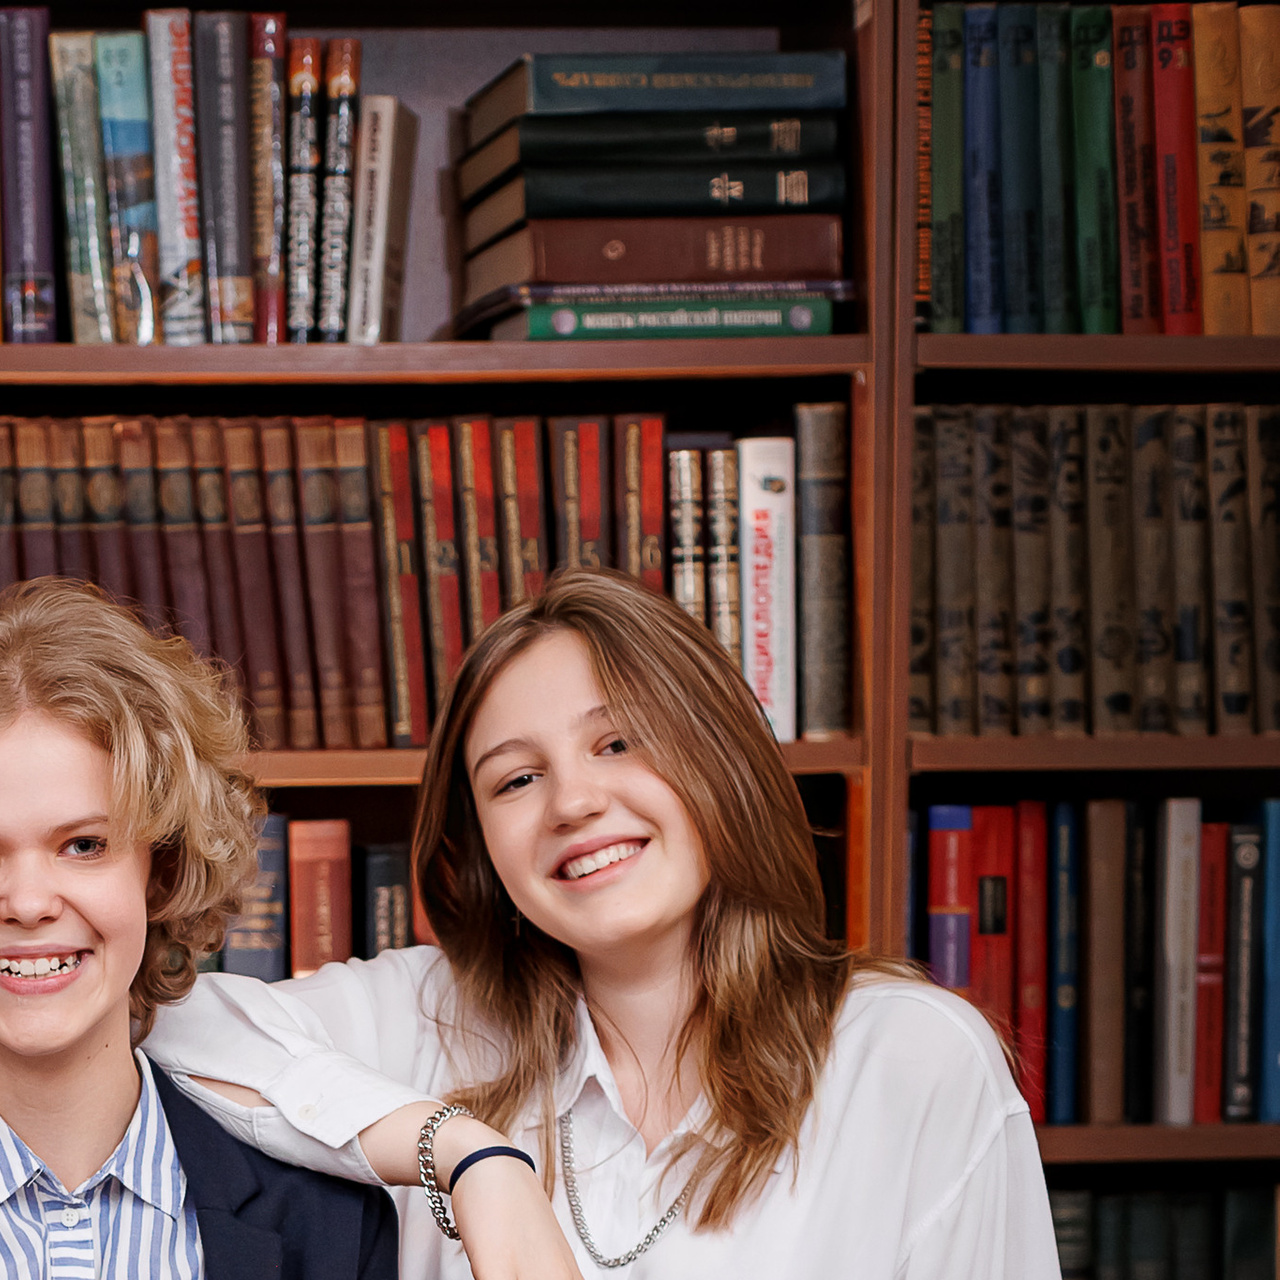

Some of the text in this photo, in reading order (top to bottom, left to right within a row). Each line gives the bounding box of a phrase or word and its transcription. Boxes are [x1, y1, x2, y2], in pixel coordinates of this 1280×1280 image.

[1158, 48, 1172, 69] 9
[398, 542, 412, 575] 1
[434, 538, 459, 573] 2
[640, 535, 662, 569] 6
